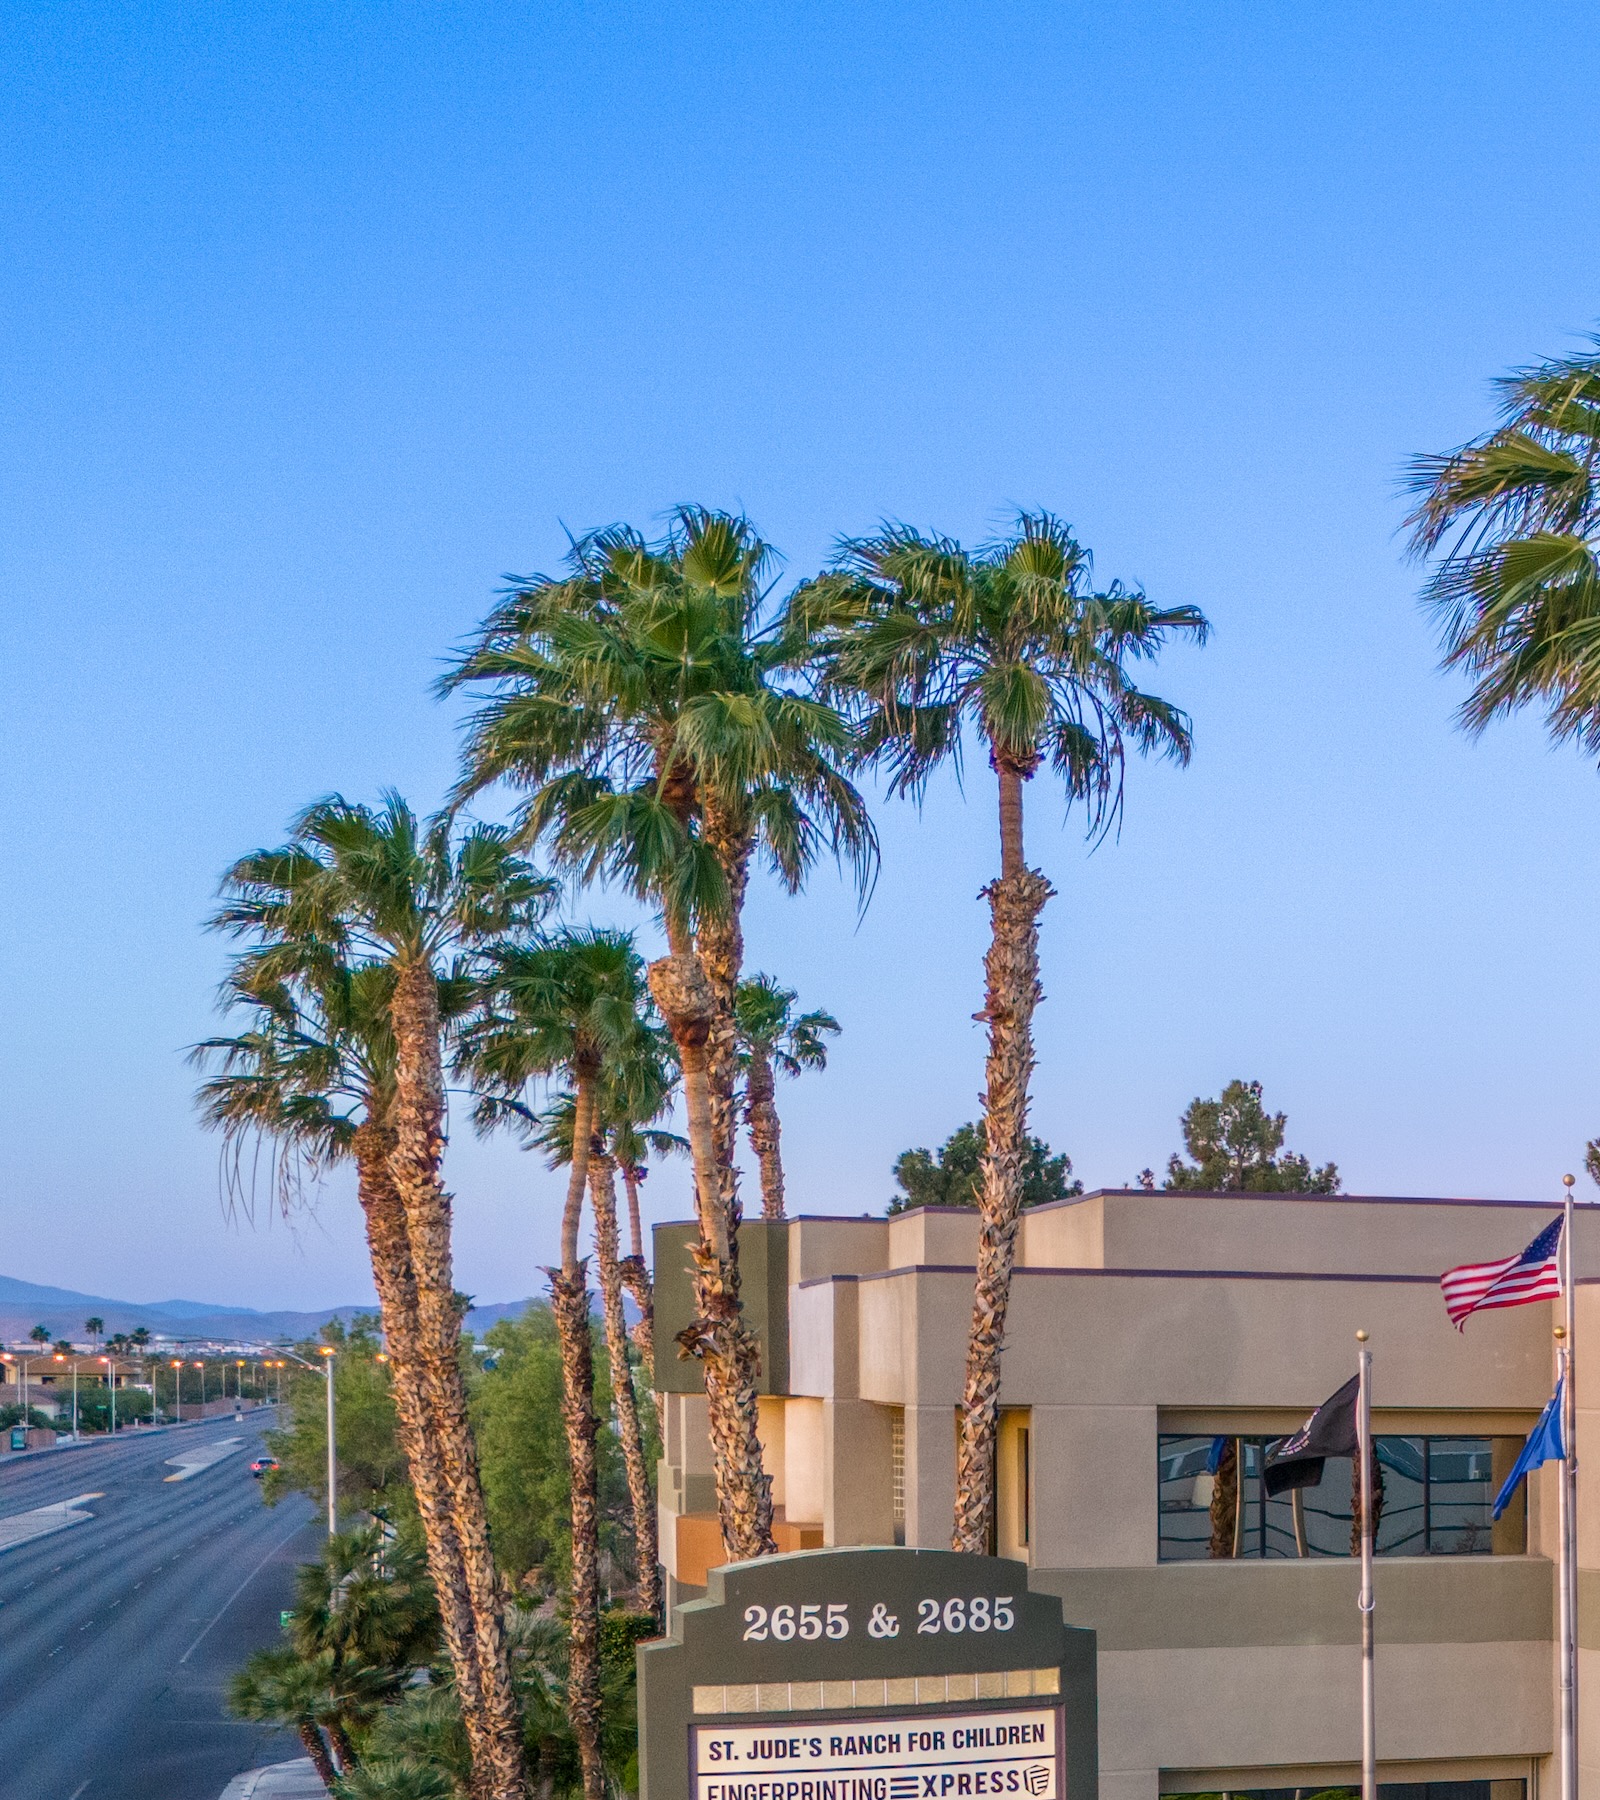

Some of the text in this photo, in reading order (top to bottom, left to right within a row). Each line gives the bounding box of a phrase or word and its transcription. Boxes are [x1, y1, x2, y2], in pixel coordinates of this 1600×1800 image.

[743, 1597, 1014, 1641] 2655 & 2685
[710, 1724, 1044, 1760] ST. JUDE'S RANCH FOR CHILDREN
